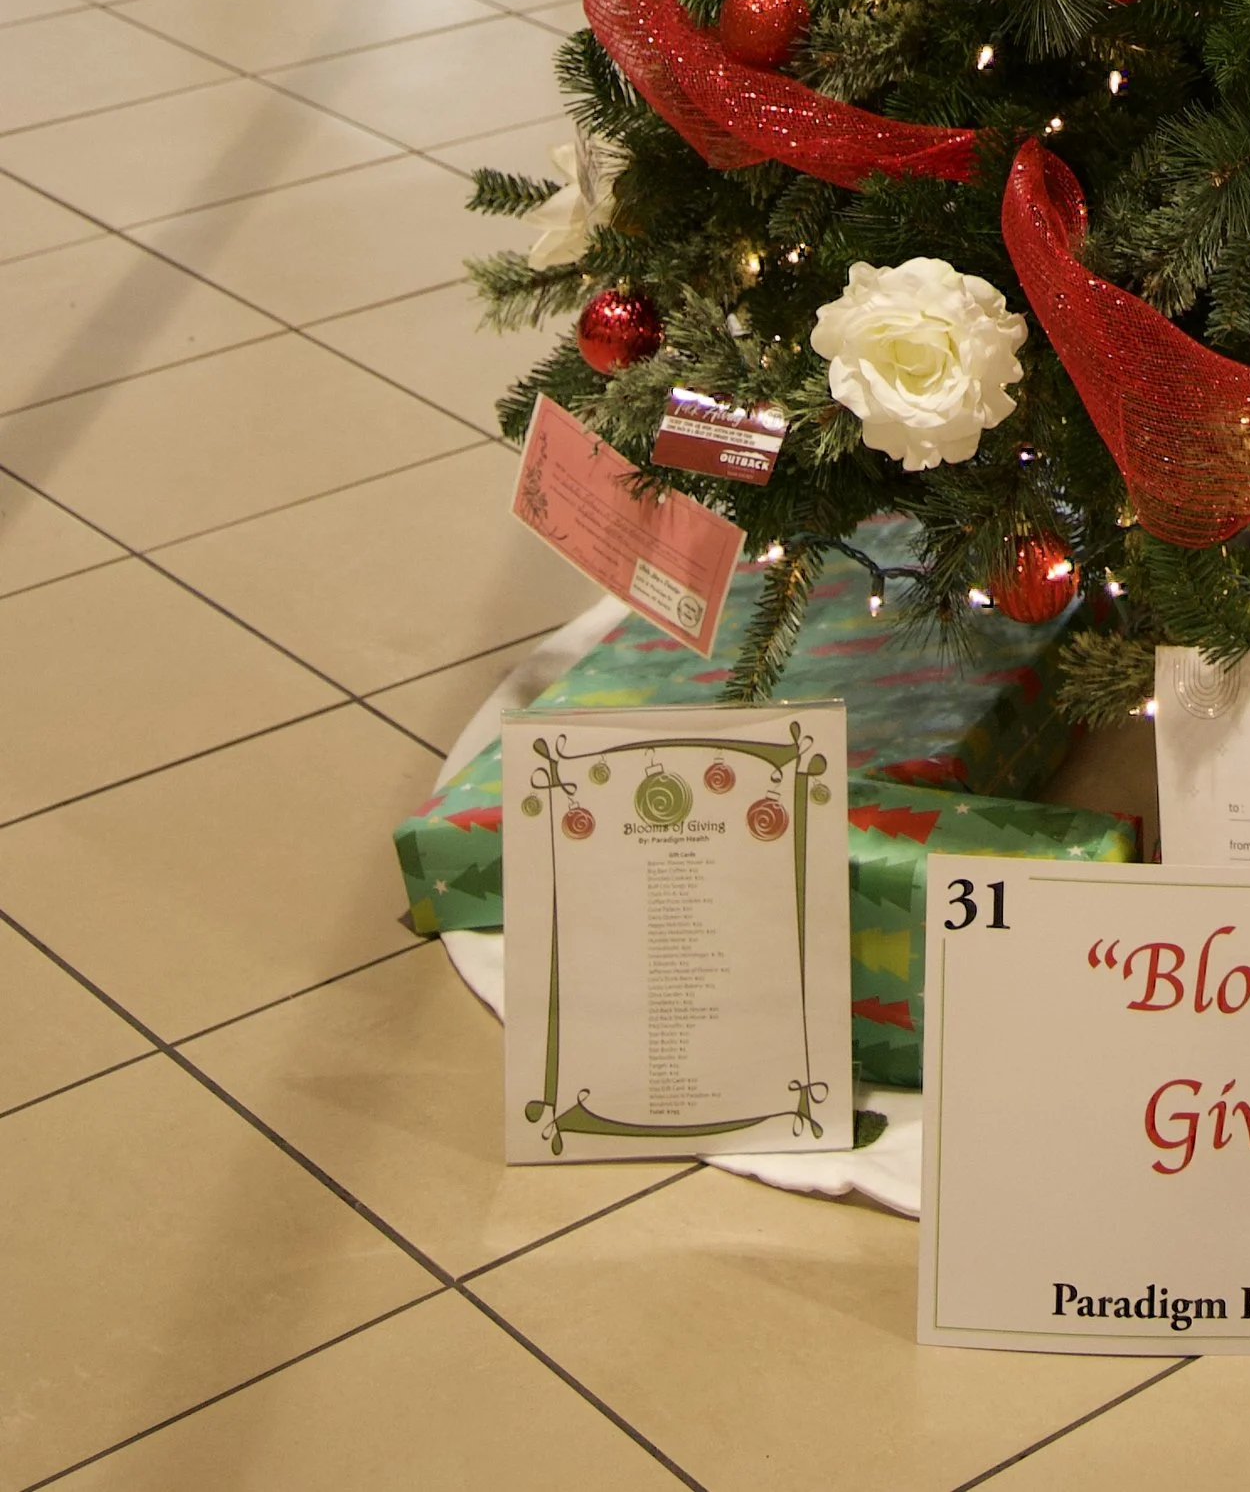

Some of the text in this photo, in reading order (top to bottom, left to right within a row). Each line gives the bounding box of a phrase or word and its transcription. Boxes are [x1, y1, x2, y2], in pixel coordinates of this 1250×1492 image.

[719, 452, 769, 471] OUTBACK
[623, 819, 726, 835] Blooms of Giving
[652, 835, 685, 844] Paradigm
[943, 878, 1012, 931] 31
[1051, 1282, 1228, 1331] Paradigm
